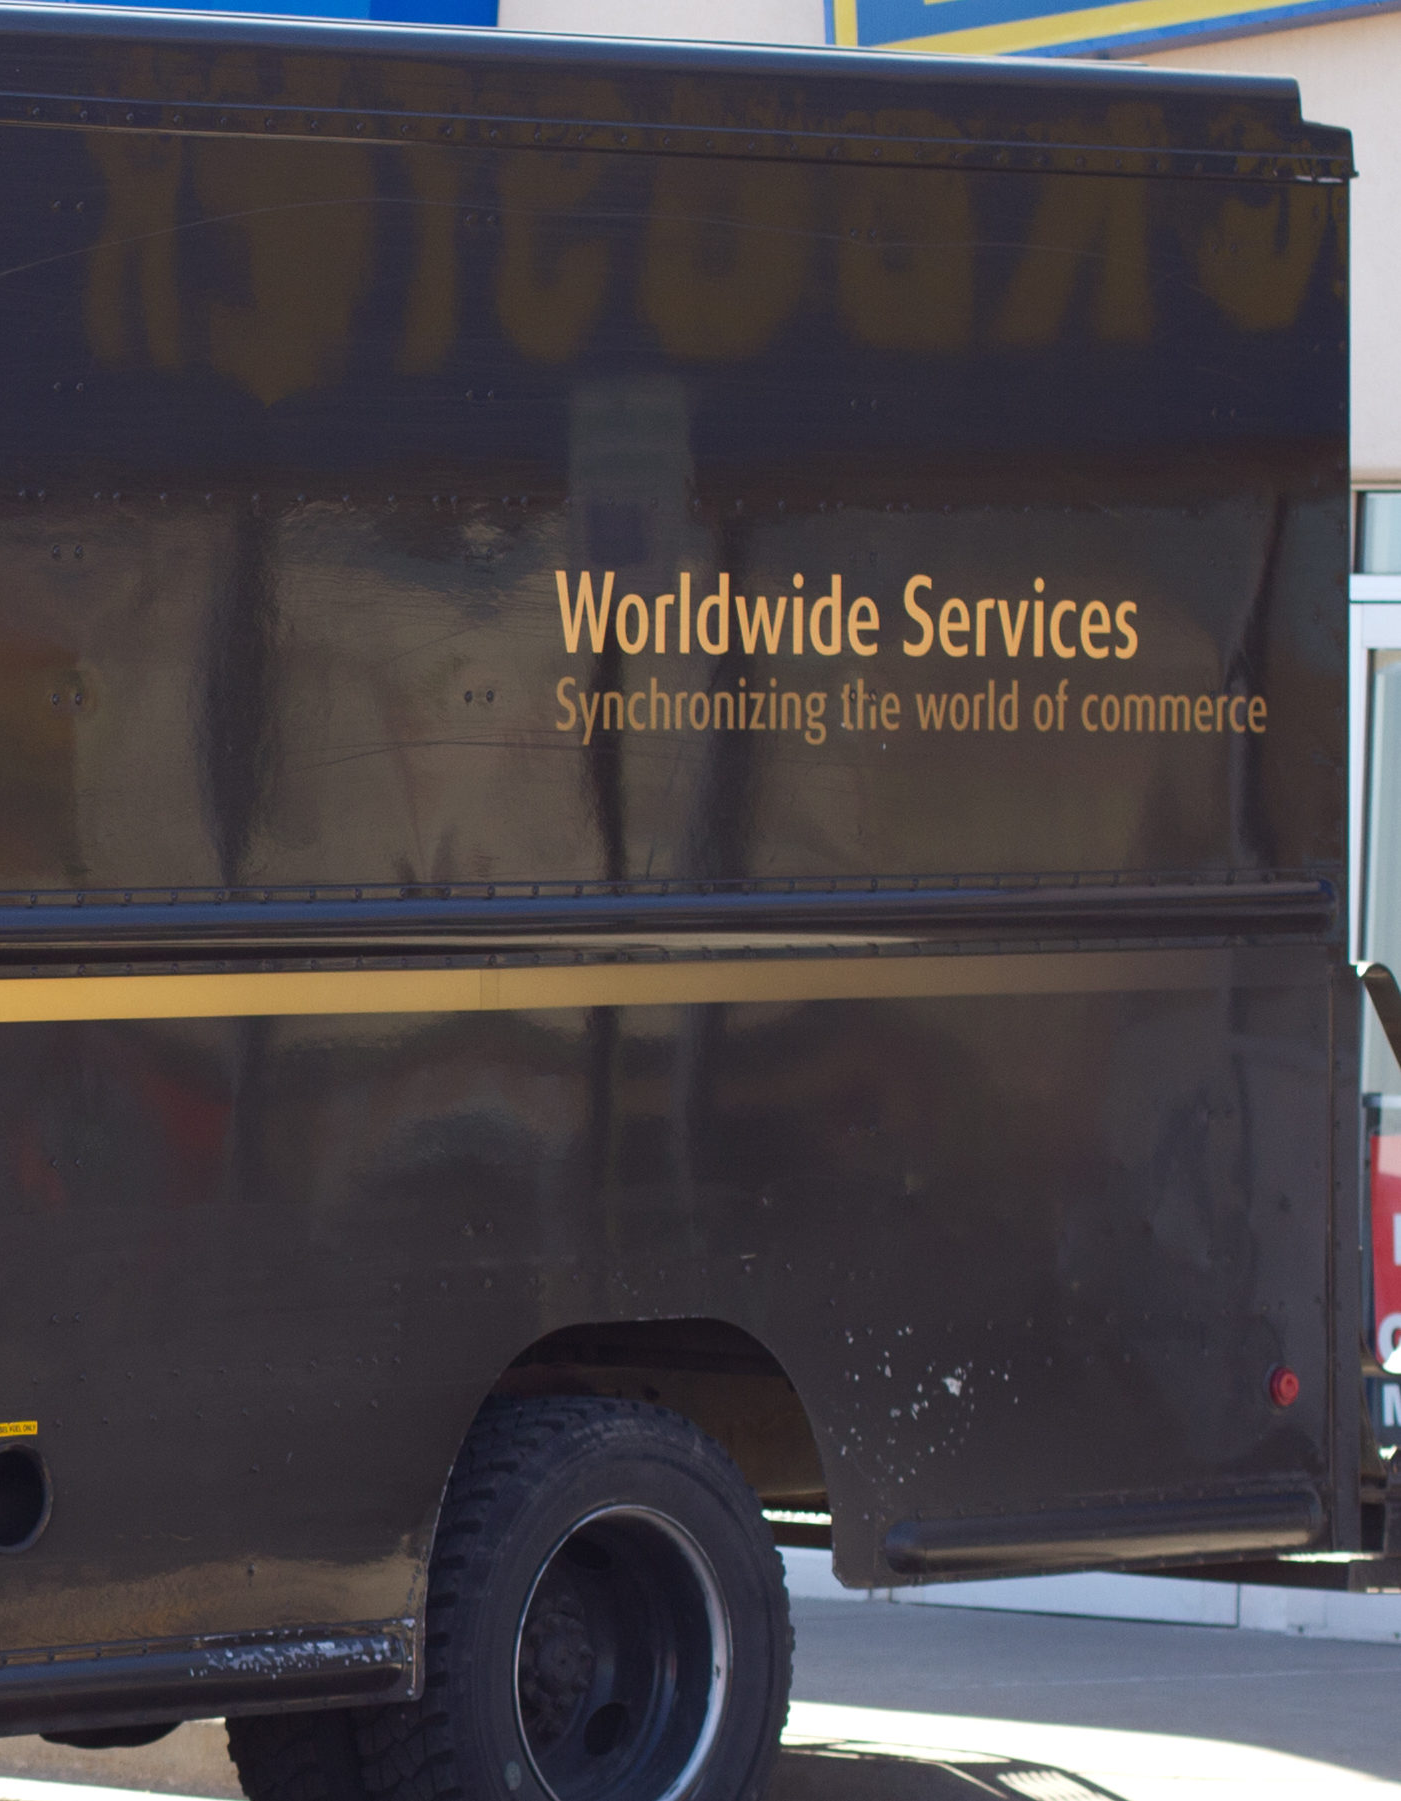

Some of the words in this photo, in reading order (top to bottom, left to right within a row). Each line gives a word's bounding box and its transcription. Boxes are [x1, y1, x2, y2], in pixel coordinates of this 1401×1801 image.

[555, 570, 880, 656] Worldwide
[903, 574, 1138, 659] Services
[555, 677, 827, 745] Synchronizing
[840, 679, 900, 732] the
[915, 680, 1018, 733] world
[1033, 679, 1069, 732] of
[1080, 696, 1268, 733] commerce
